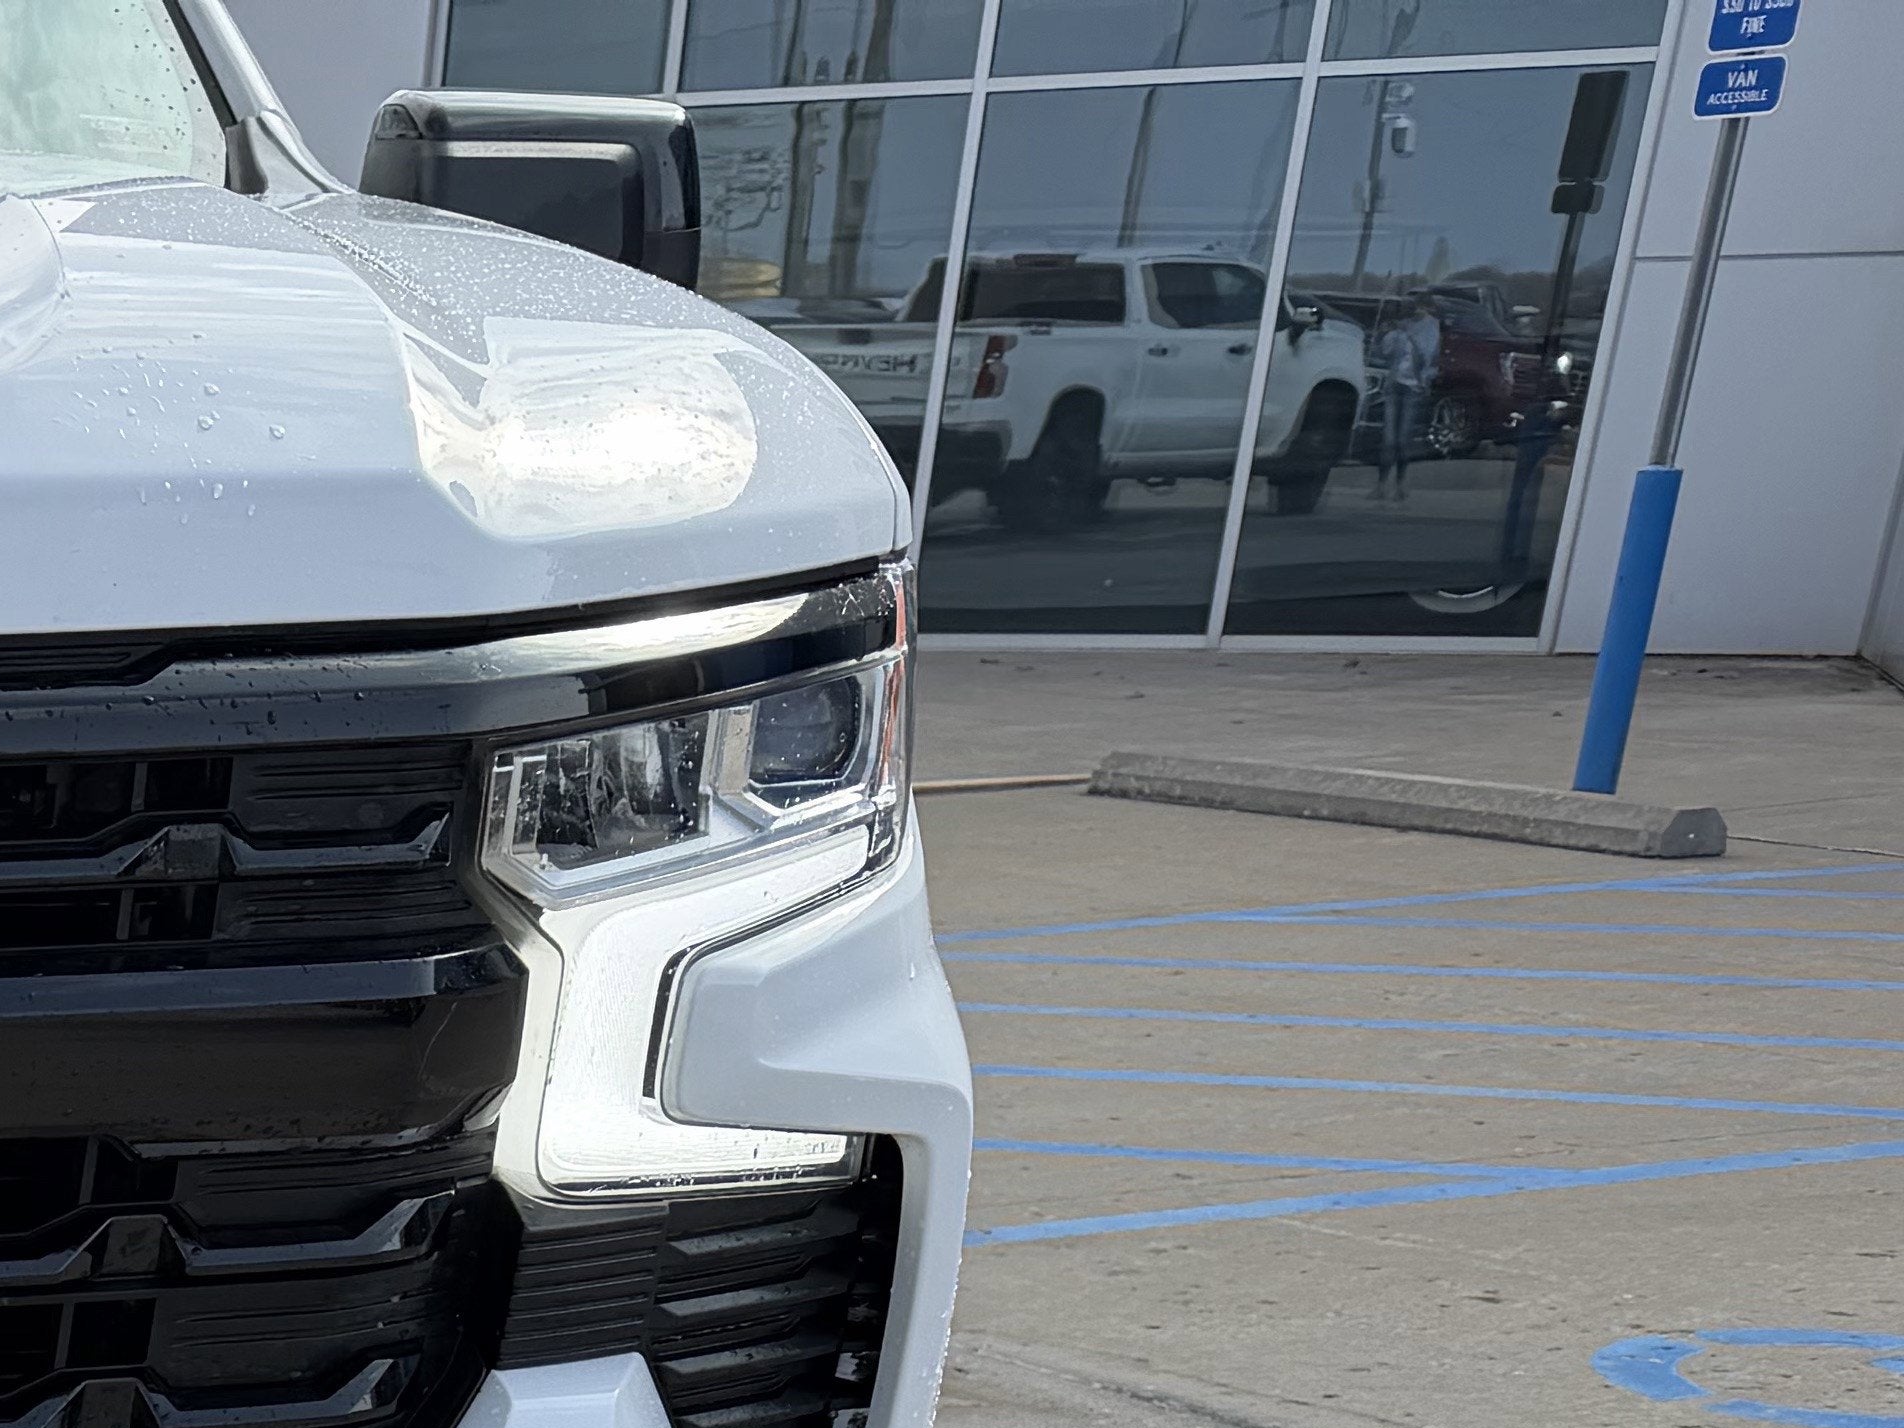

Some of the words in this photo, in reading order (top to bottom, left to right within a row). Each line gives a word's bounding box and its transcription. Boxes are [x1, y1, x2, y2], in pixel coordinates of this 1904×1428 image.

[1741, 16, 1768, 34] FINE
[1728, 70, 1758, 87] VAN
[1707, 89, 1768, 104] ACCESSIBLE
